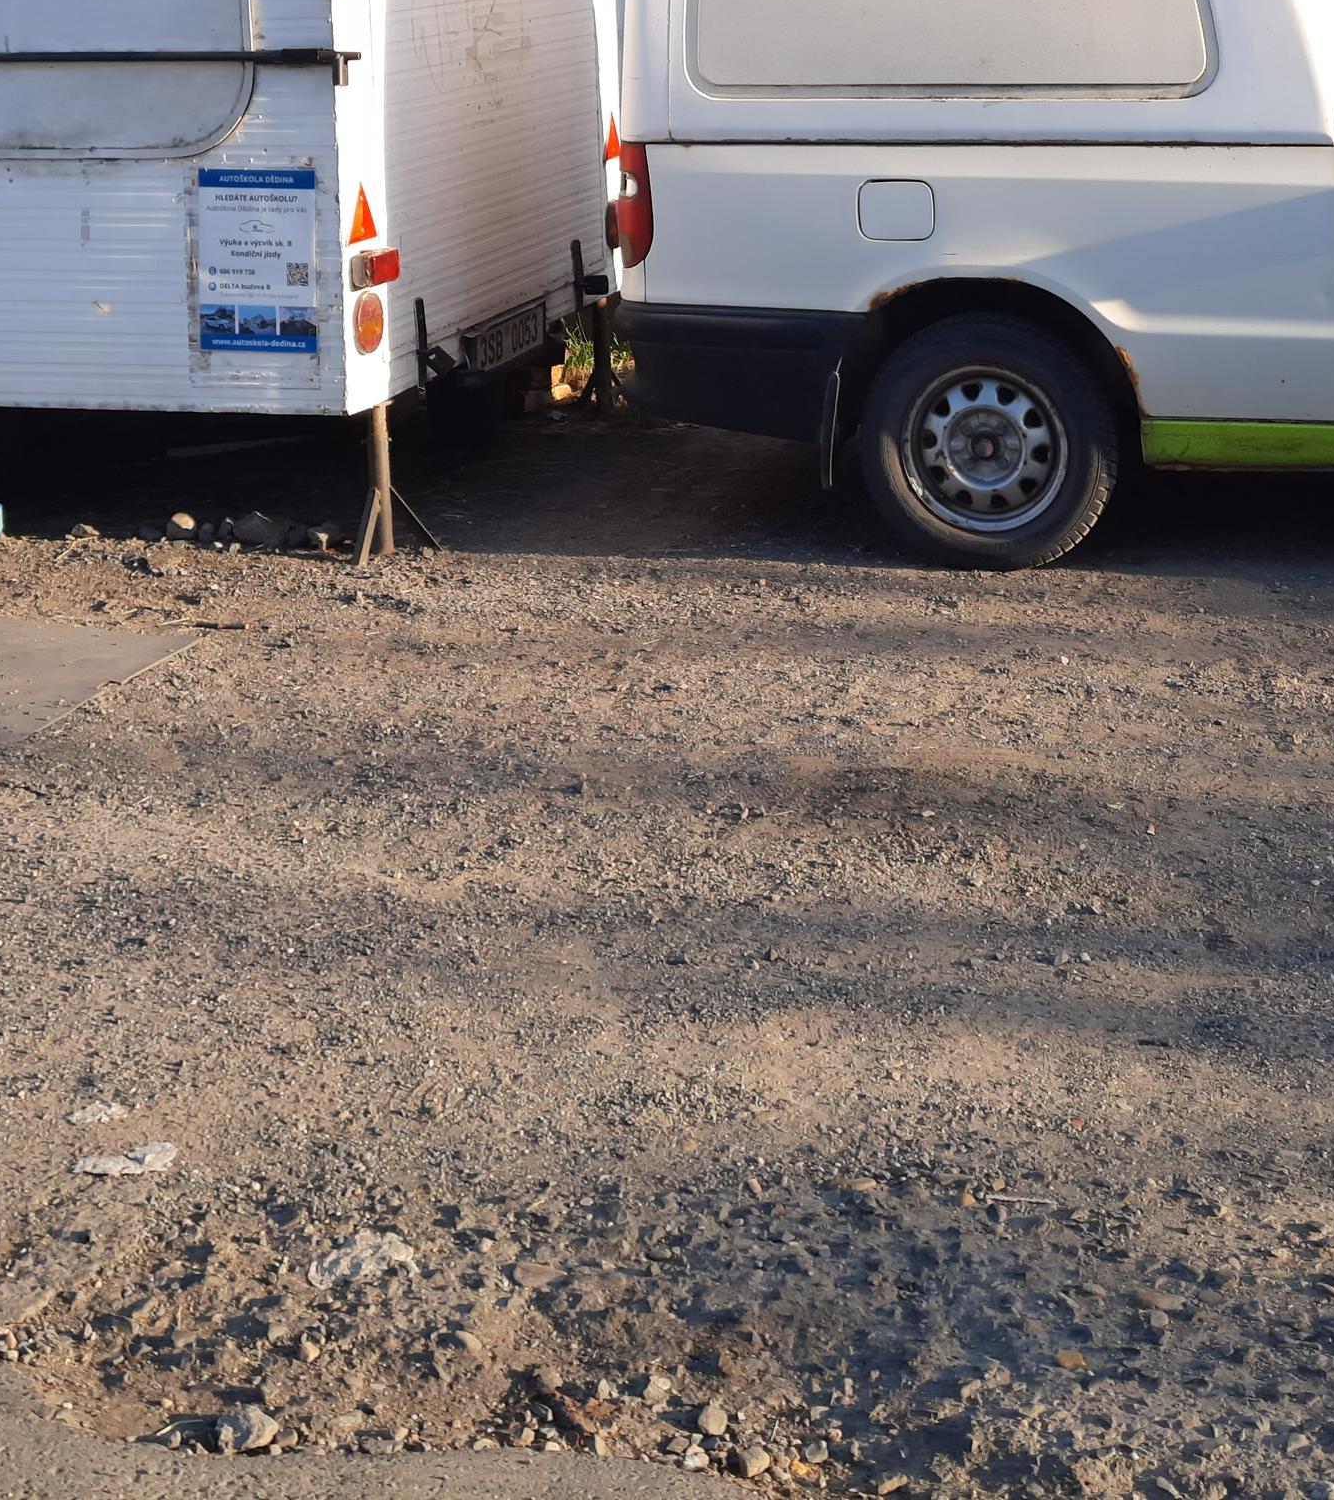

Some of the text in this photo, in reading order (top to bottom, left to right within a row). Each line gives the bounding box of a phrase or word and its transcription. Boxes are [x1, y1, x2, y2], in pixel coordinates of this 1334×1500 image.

[219, 174, 294, 184] AUTOŠKOLA DĚDINA
[215, 193, 298, 203] HLEDÁTE AUTOŠKOLU?
[219, 238, 242, 247] Výuka
[250, 238, 273, 248] výcvik
[274, 238, 285, 247] sk.
[231, 250, 282, 259] Kondiční jízdy
[211, 339, 307, 348] www.autoskola-dedina.cz
[480, 313, 538, 367] 3SB 0053
